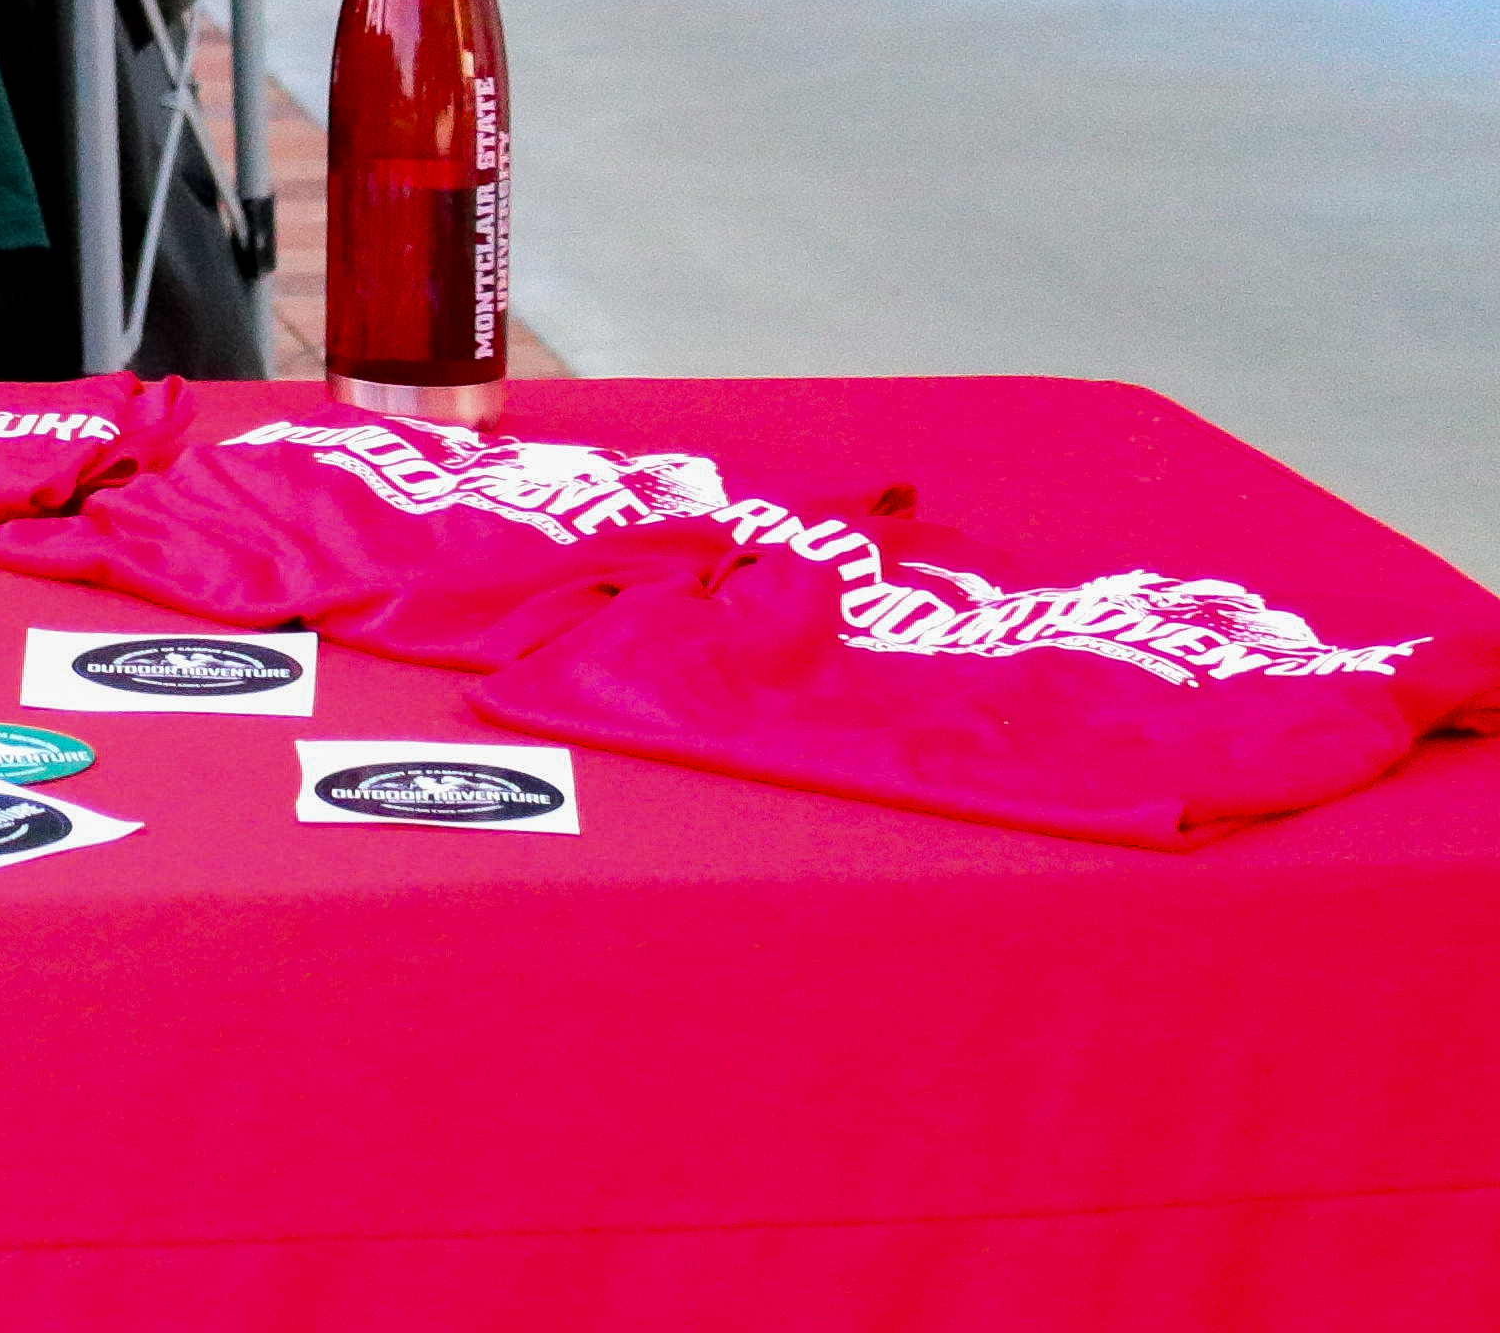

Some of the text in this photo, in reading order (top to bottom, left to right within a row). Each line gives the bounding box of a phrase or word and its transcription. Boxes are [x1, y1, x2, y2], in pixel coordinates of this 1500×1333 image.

[474, 76, 497, 360] MONTCLAIR STATE
[86, 662, 291, 679] OUTDOOR ADVENTURE
[331, 787, 552, 806] OUTDOOR ADVENTURE
